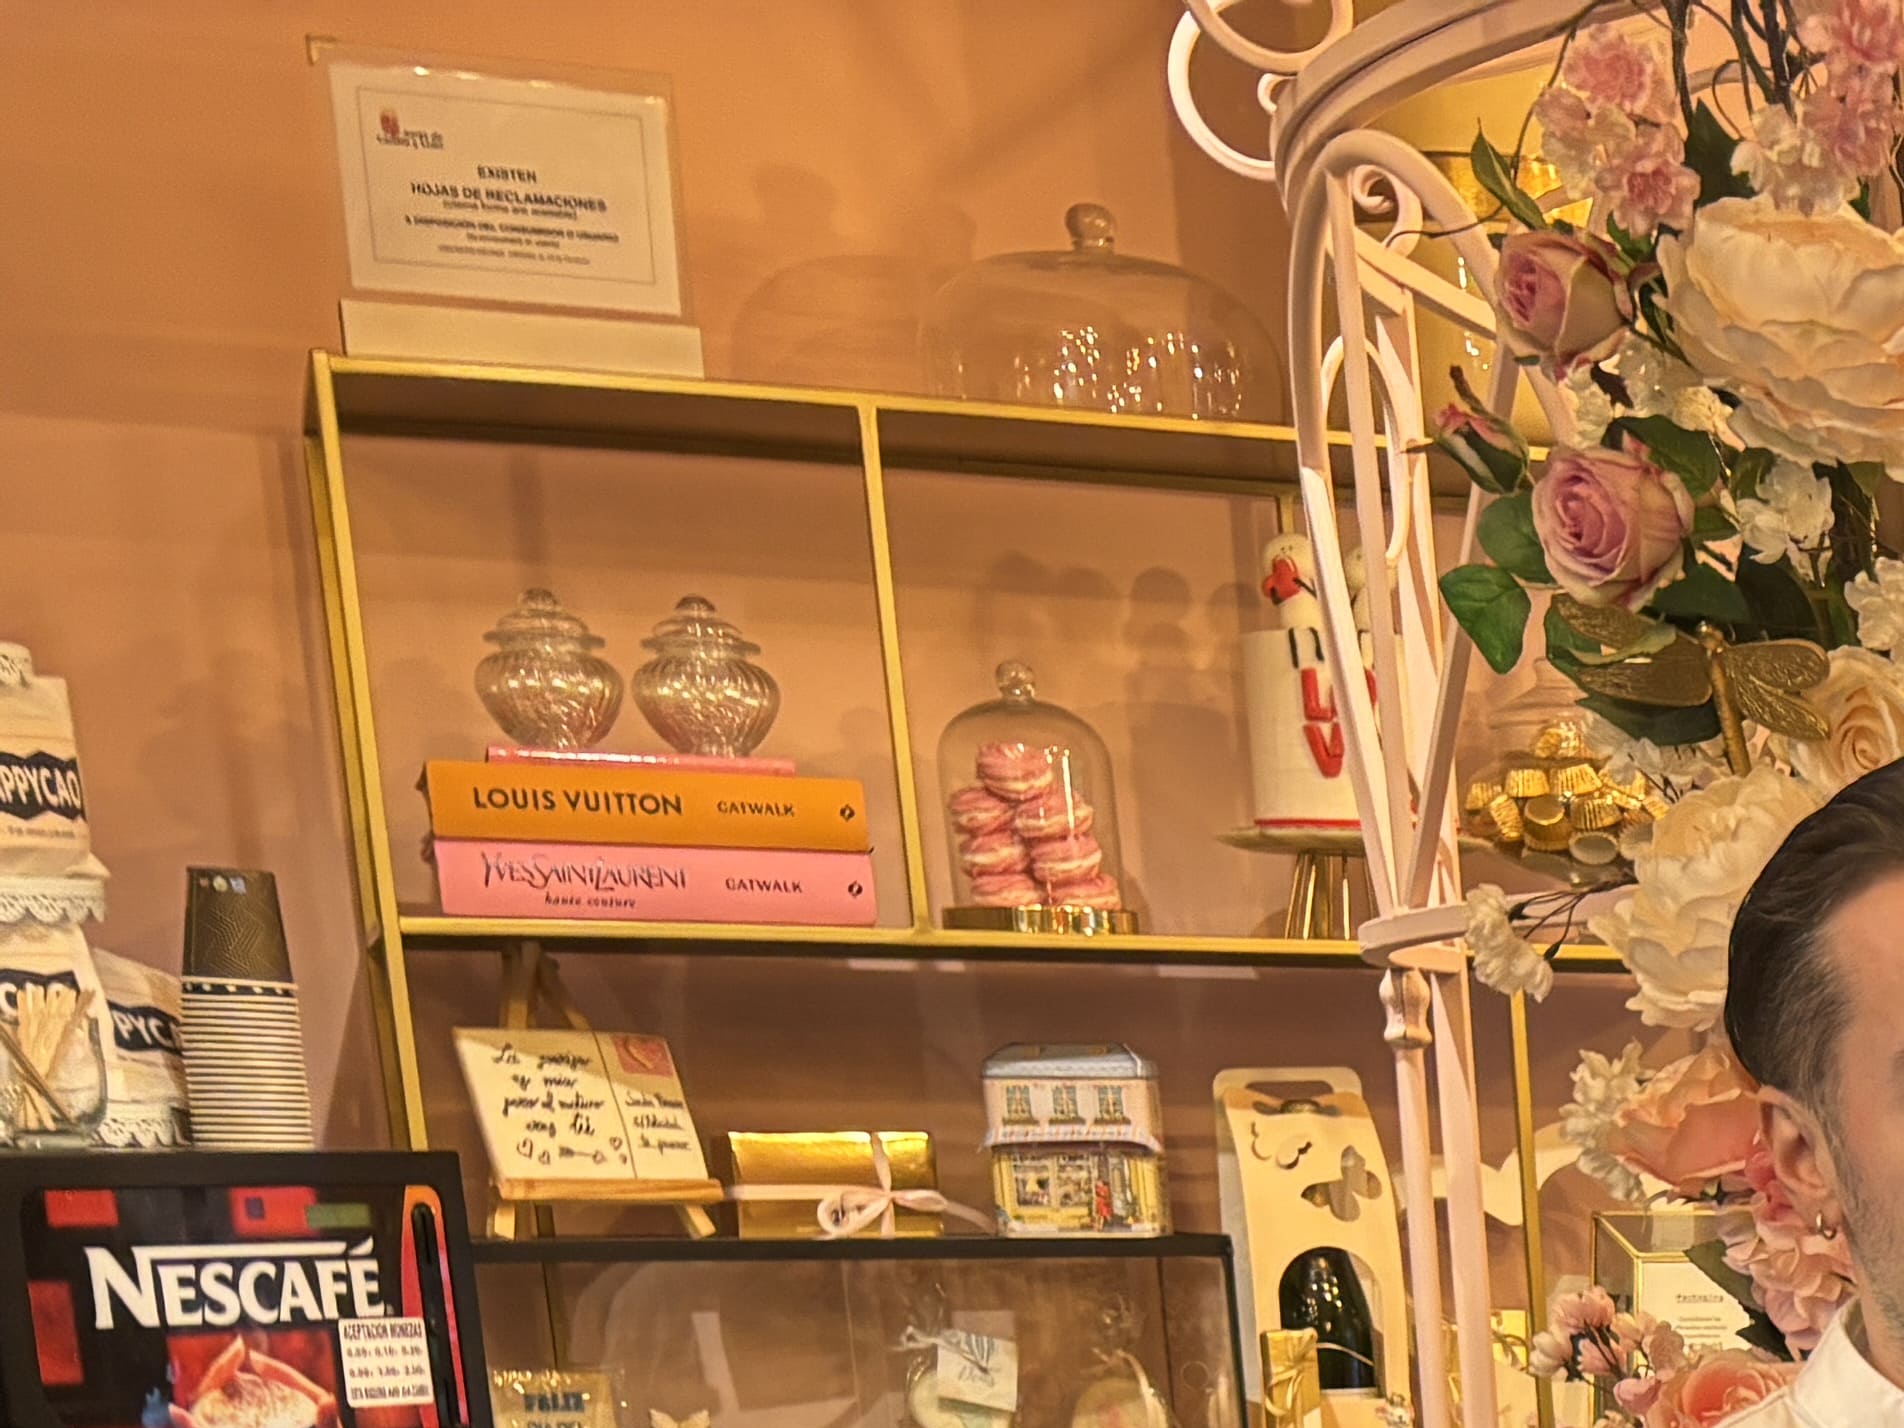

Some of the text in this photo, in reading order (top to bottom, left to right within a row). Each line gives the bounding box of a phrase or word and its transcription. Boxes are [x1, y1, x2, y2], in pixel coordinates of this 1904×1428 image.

[472, 786, 795, 817] LOUIS VUITTON CATWALK
[725, 877, 802, 894] CATWALK
[84, 1235, 386, 1330] NESCAFÉ
